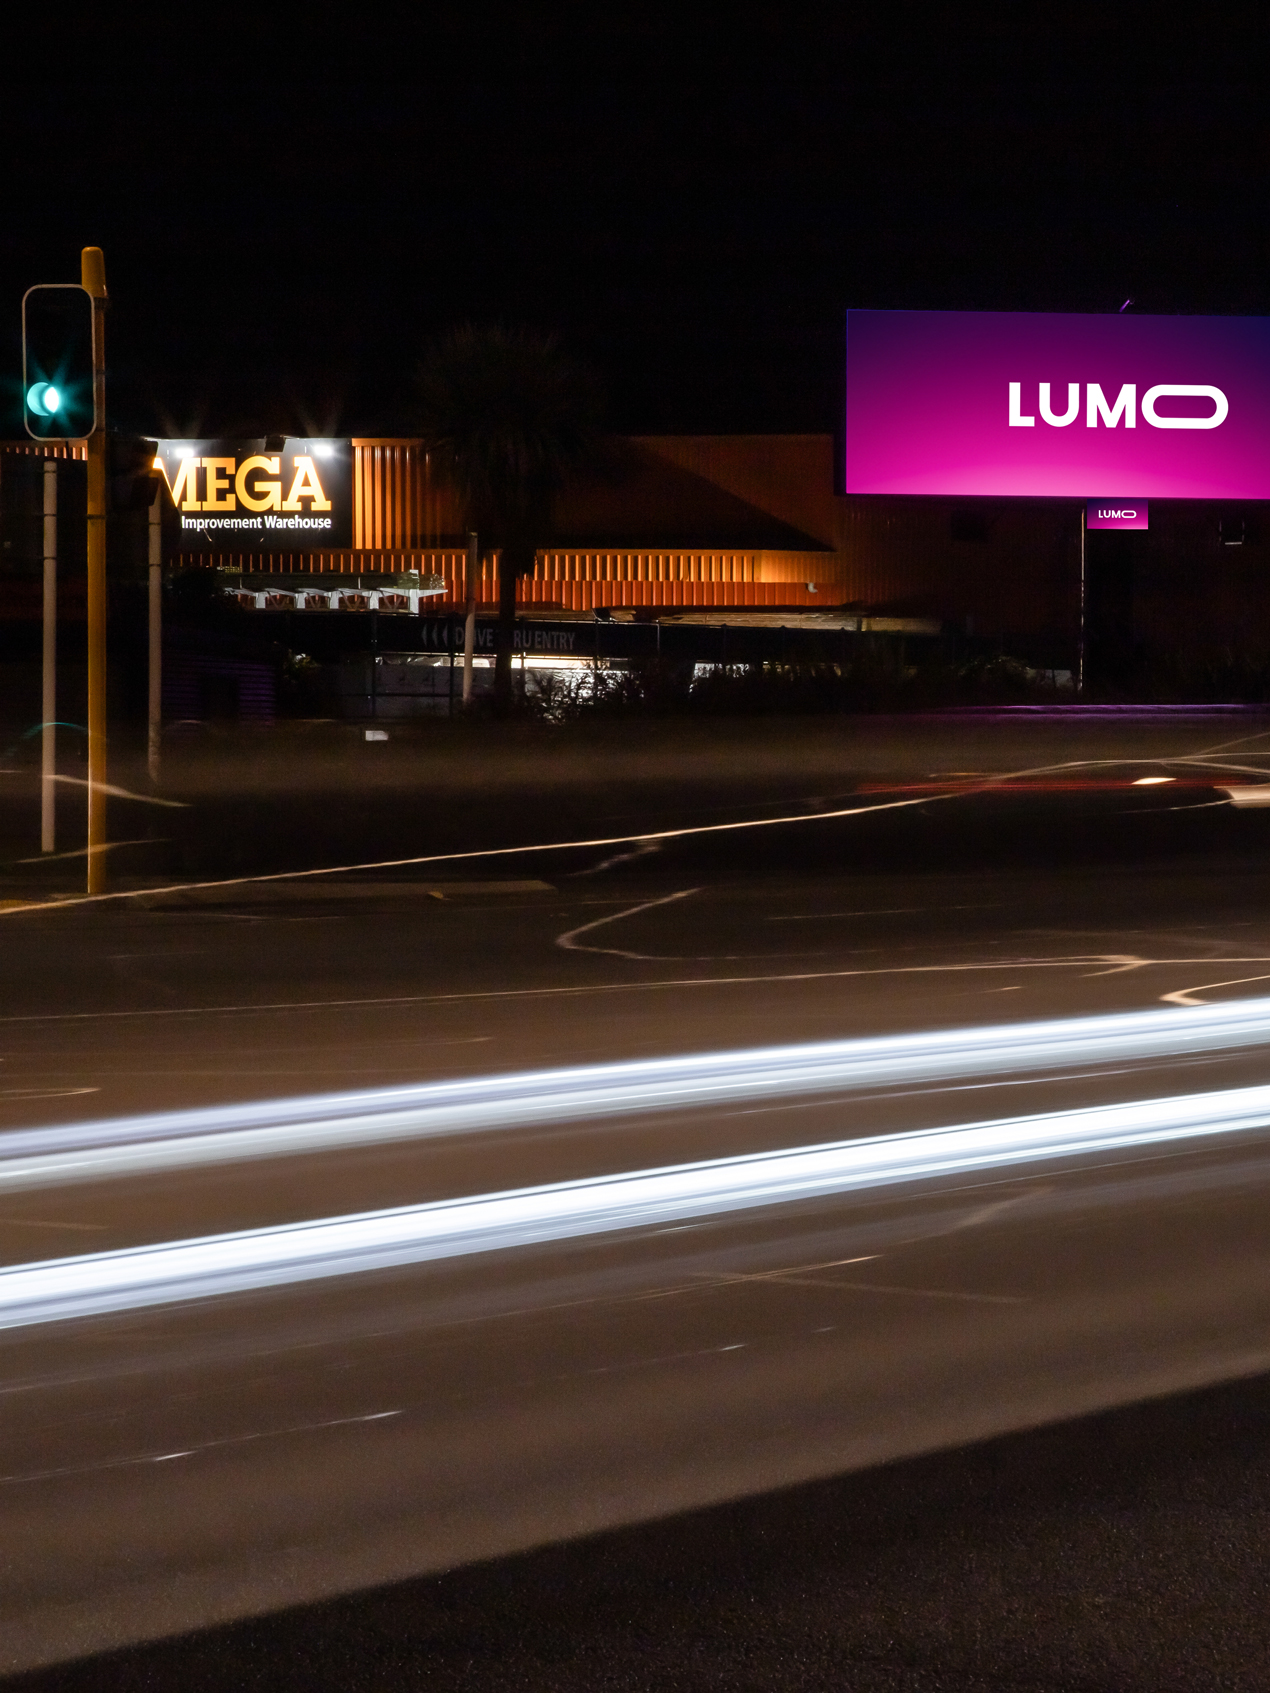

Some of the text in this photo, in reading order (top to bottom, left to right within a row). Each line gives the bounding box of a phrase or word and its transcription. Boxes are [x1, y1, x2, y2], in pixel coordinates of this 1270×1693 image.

[1008, 382, 1229, 430] LUMO
[152, 455, 332, 512] MEGA
[181, 514, 332, 532] Improvement Warehouse
[1098, 509, 1137, 519] LUMO
[455, 626, 494, 647] DIVE
[534, 630, 576, 650] ENTRY
